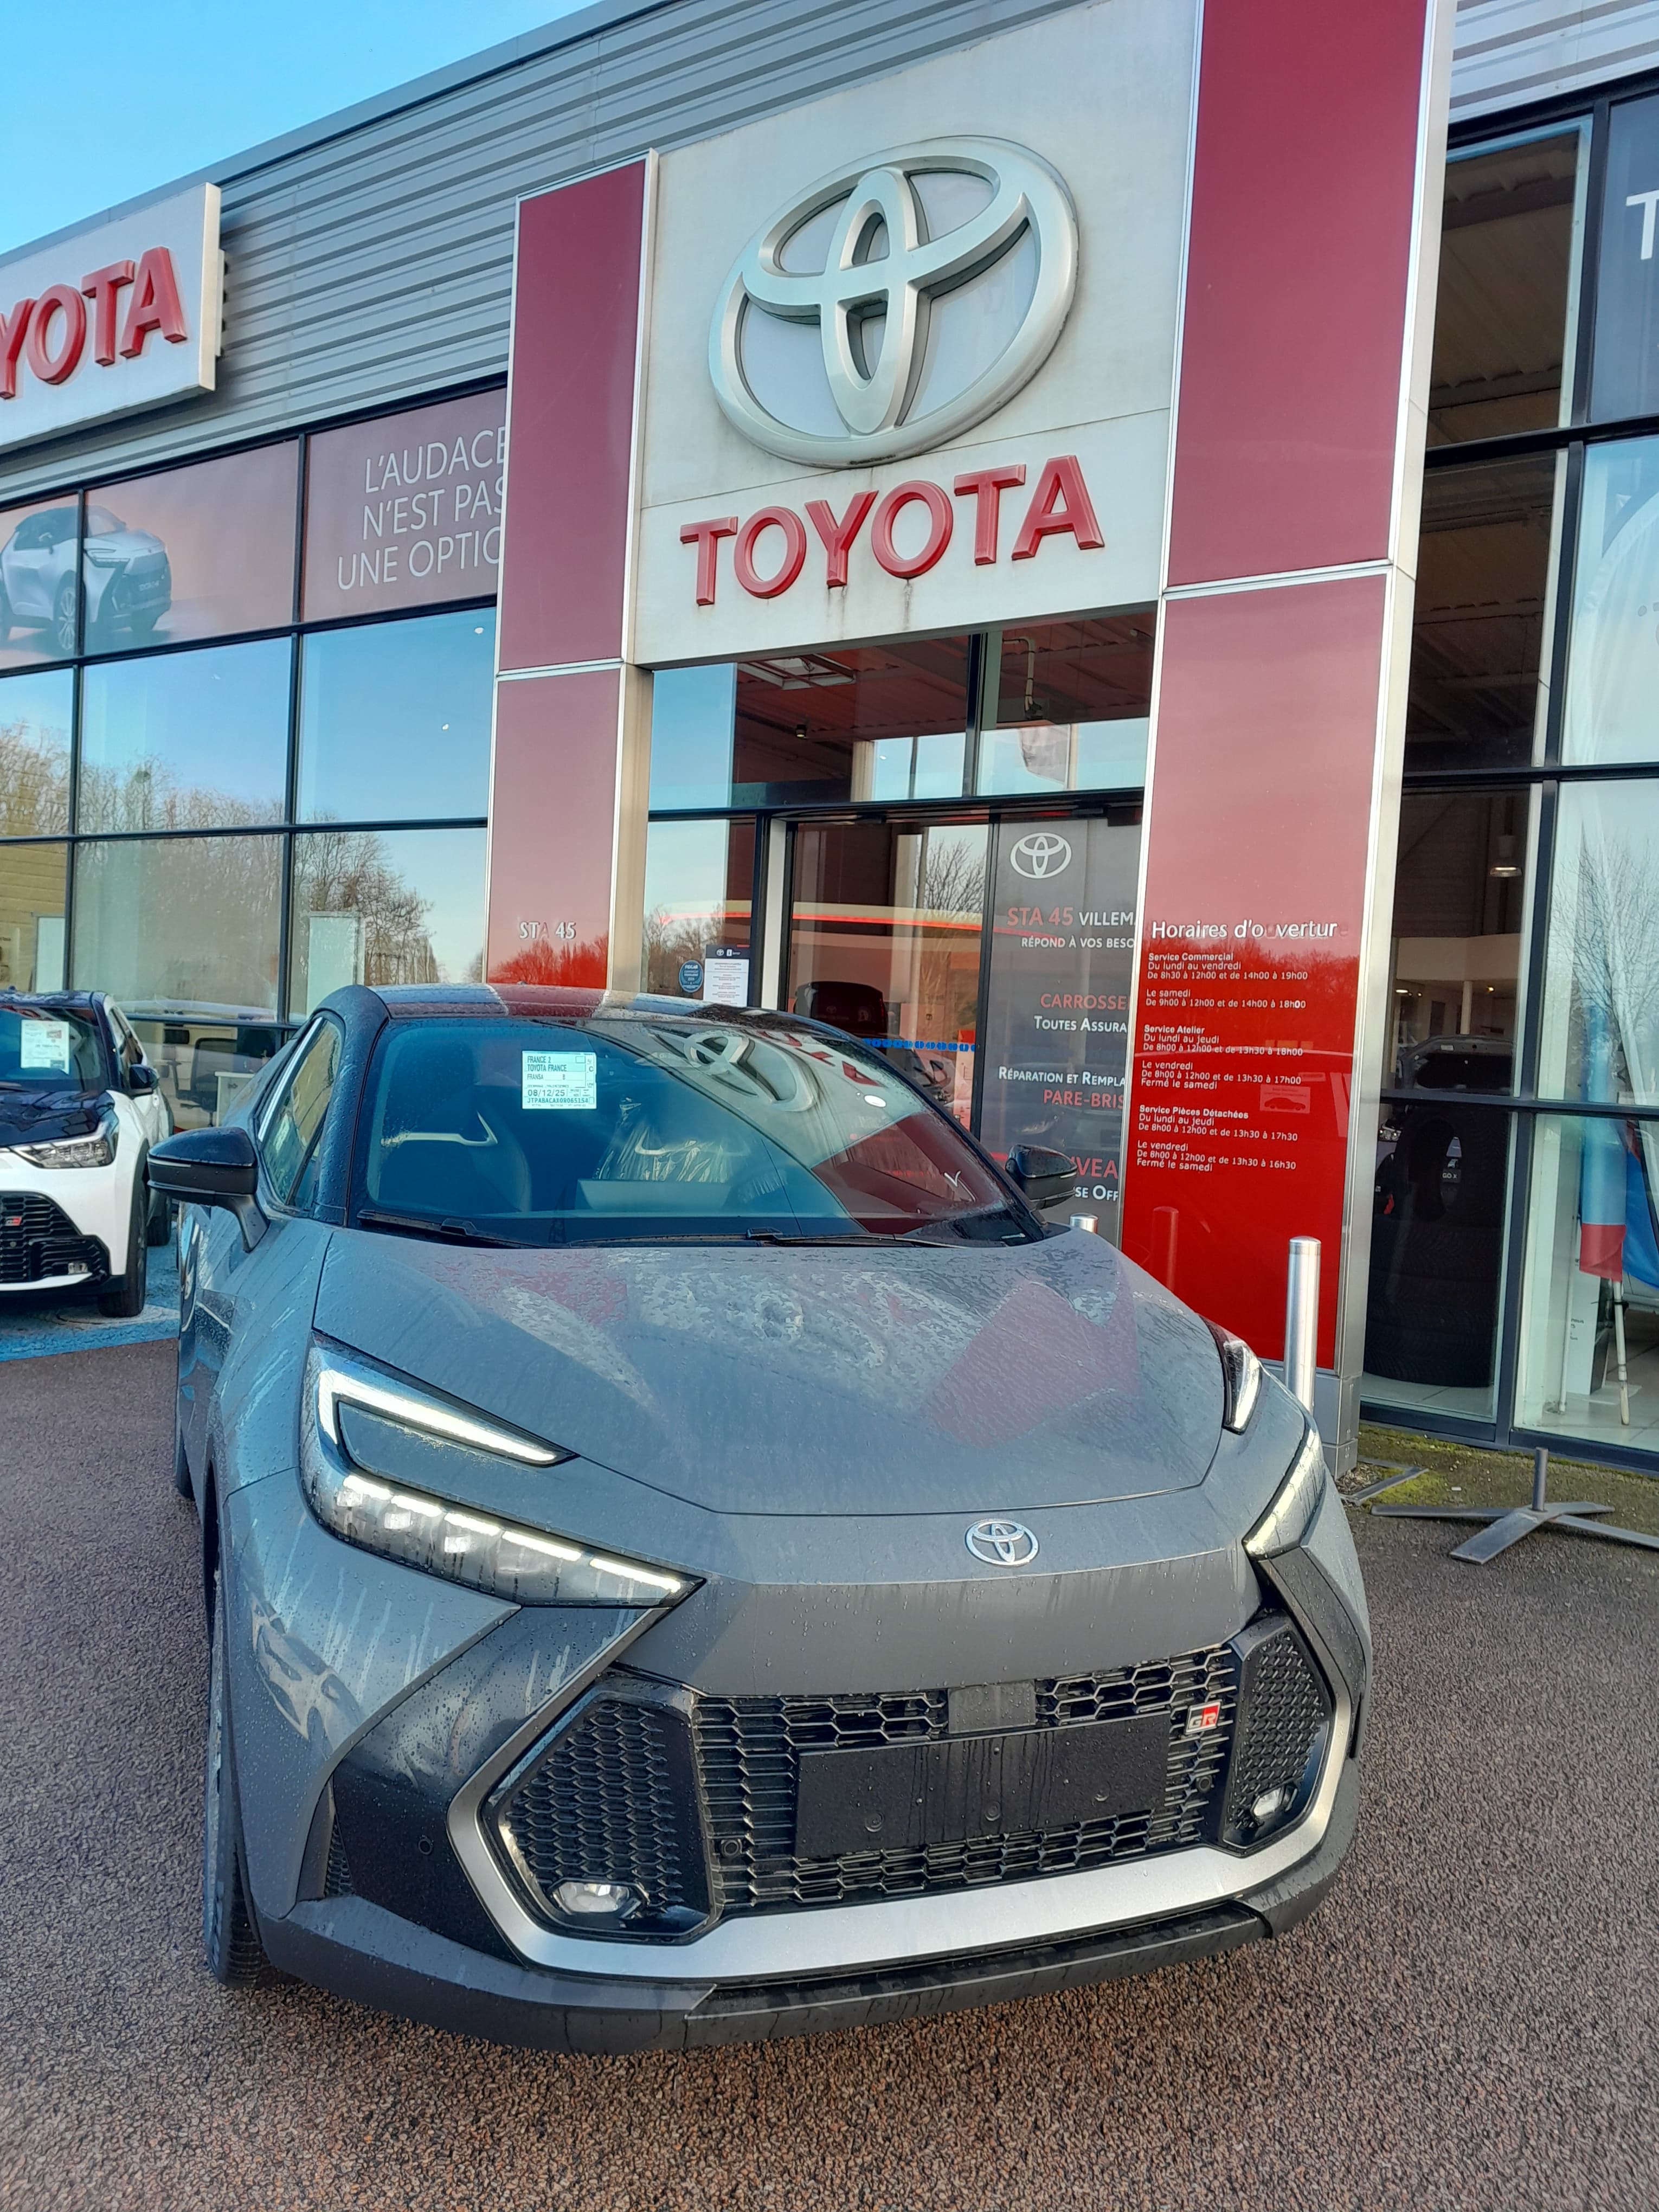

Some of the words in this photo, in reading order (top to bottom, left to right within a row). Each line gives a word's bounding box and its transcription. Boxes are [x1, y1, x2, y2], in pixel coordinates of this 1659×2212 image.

[363, 489, 445, 541] N'EST
[680, 454, 1105, 606] TOYOTA
[338, 546, 398, 590] UNE
[1007, 906, 1043, 926] STA
[1049, 906, 1073, 926] 45
[1079, 912, 1135, 925] VILLEM
[555, 921, 576, 939] 45
[1152, 921, 1227, 939] Horaires
[1021, 935, 1065, 948] RÉPOND
[1069, 935, 1077, 948] À
[1080, 938, 1103, 948] VOS
[1148, 953, 1179, 961] Service
[1182, 953, 1233, 961] Commercial
[1148, 962, 1160, 970] Du
[1163, 962, 1184, 970] lundi
[1202, 962, 1241, 970] vendredi
[1183, 971, 1188, 979] à
[1244, 972, 1270, 980] 14h00
[1272, 971, 1277, 980] à
[1281, 972, 1308, 980] 19h00
[1159, 989, 1191, 998] samedi
[1159, 999, 1179, 1007] 9h00
[1181, 998, 1186, 1007] à
[1190, 999, 1214, 1007] 12h00
[1228, 1000, 1238, 1008] de
[1242, 1000, 1268, 1008] 14h00
[1271, 999, 1276, 1008] à
[1279, 1000, 1306, 1009] 18h00
[1144, 1025, 1174, 1033] Service
[1177, 1025, 1205, 1034] Atelier
[1159, 1034, 1180, 1043] lundi
[1196, 1035, 1219, 1045] jeudi
[1179, 1043, 1183, 1052] à
[1187, 1045, 1212, 1053] 12h00
[1267, 1046, 1272, 1055] à
[1276, 1048, 1303, 1056] 18h00
[1142, 1060, 1152, 1069] Le
[1155, 1061, 1193, 1070] vendredi
[1141, 1078, 1168, 1088] Fermé
[1173, 1080, 1180, 1088] le
[1184, 1081, 1217, 1089] samedi
[1155, 1070, 1174, 1078] 8h00
[1177, 1070, 1181, 1078] à
[1185, 1071, 1210, 1080] 12h00
[1224, 1073, 1233, 1081] de
[1237, 1074, 1263, 1083] 13h30
[1266, 1074, 1271, 1083] à
[1275, 1076, 1301, 1084] 17h00
[528, 1089, 565, 1097] 08/12/25
[1140, 1105, 1169, 1114] Service
[1173, 1106, 1200, 1116] Pièces
[1203, 1108, 1249, 1118] Détachées
[1139, 1114, 1150, 1122] Du
[1154, 1114, 1175, 1123] lundi
[1192, 1117, 1214, 1127] jeudi
[1152, 1123, 1171, 1132] 8h00
[1174, 1123, 1179, 1133] à
[1182, 1126, 1207, 1134] 12h00
[1220, 1128, 1230, 1136] de
[1234, 1129, 1259, 1139] 13h30
[1263, 1130, 1268, 1139] à
[1271, 1132, 1298, 1141] 17h30
[1150, 1141, 1188, 1152] vendredi
[1137, 1158, 1165, 1168] Fermé
[1168, 1160, 1175, 1168] le
[1179, 1161, 1212, 1172] samedi
[1150, 1150, 1169, 1159] 8h00
[1172, 1150, 1177, 1160] à
[1180, 1153, 1205, 1162] 12h00
[1219, 1155, 1229, 1164] de
[1232, 1157, 1258, 1167] 13h30
[1261, 1158, 1266, 1167] à
[1270, 1160, 1296, 1169] 16h30
